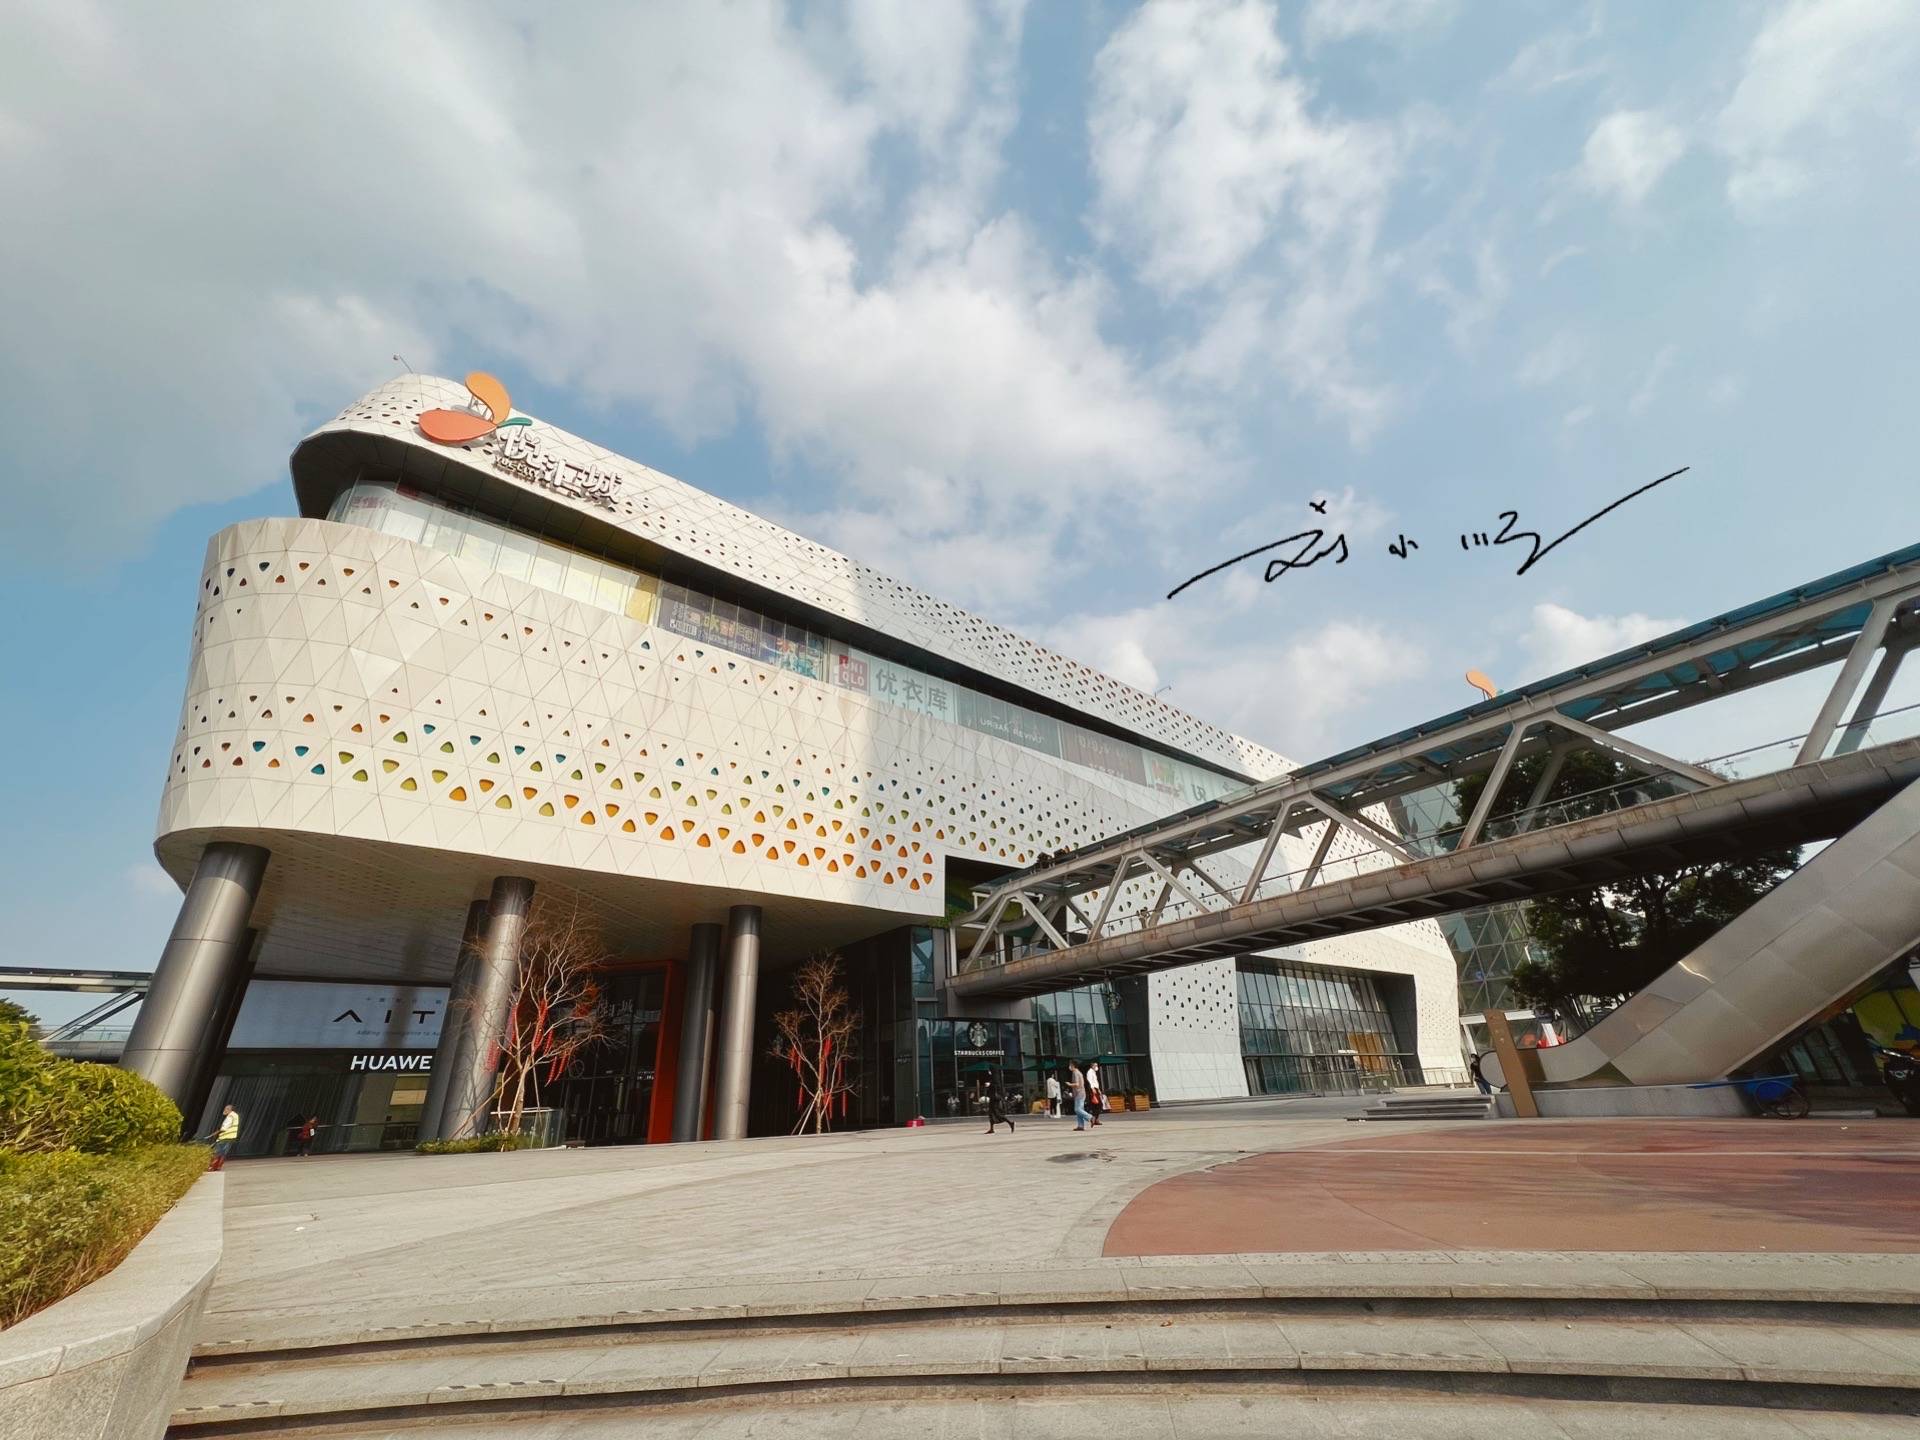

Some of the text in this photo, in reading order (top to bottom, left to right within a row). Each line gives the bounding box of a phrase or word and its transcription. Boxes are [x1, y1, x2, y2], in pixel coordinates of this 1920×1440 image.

[499, 427, 623, 503] 悦汇城
[875, 668, 948, 712] 优衣库
[332, 1009, 436, 1024] AIT
[350, 1055, 433, 1071] HUAWE
